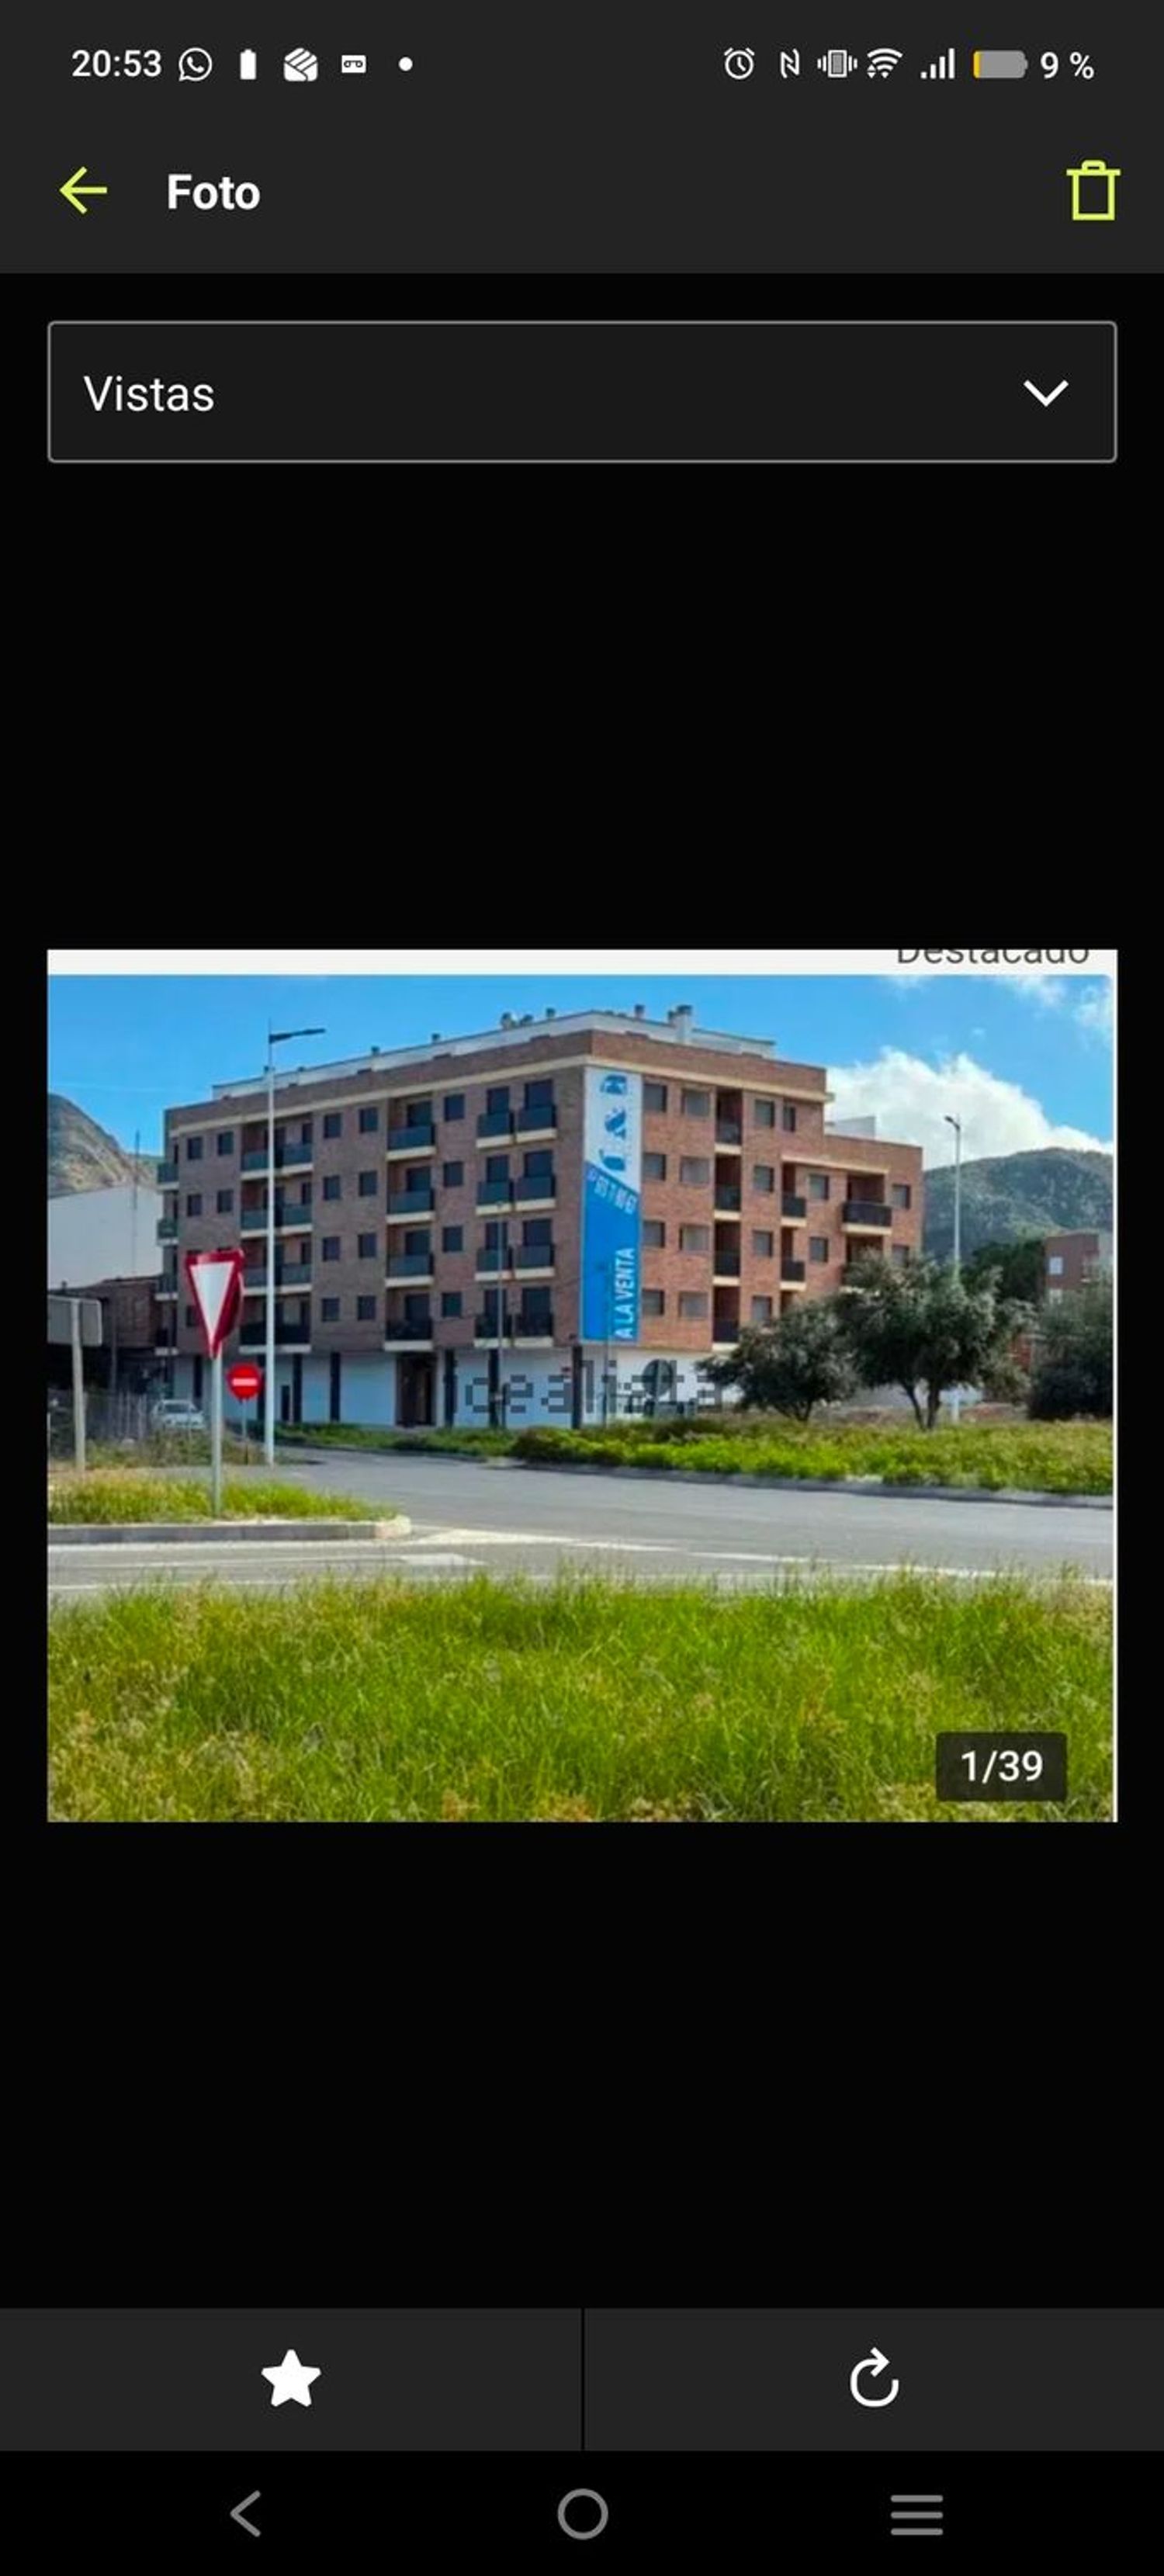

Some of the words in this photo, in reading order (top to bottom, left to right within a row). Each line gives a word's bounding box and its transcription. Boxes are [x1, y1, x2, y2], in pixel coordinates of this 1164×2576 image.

[72, 49, 162, 78] 20:53
[1040, 51, 1059, 79] 9
[1069, 52, 1095, 80] %
[168, 173, 261, 210] Foto
[83, 375, 214, 412] Vistas
[615, 1247, 636, 1301] VENTA
[615, 1304, 634, 1324] LA
[615, 1327, 633, 1339] A
[961, 1750, 1043, 1784] 1/39
